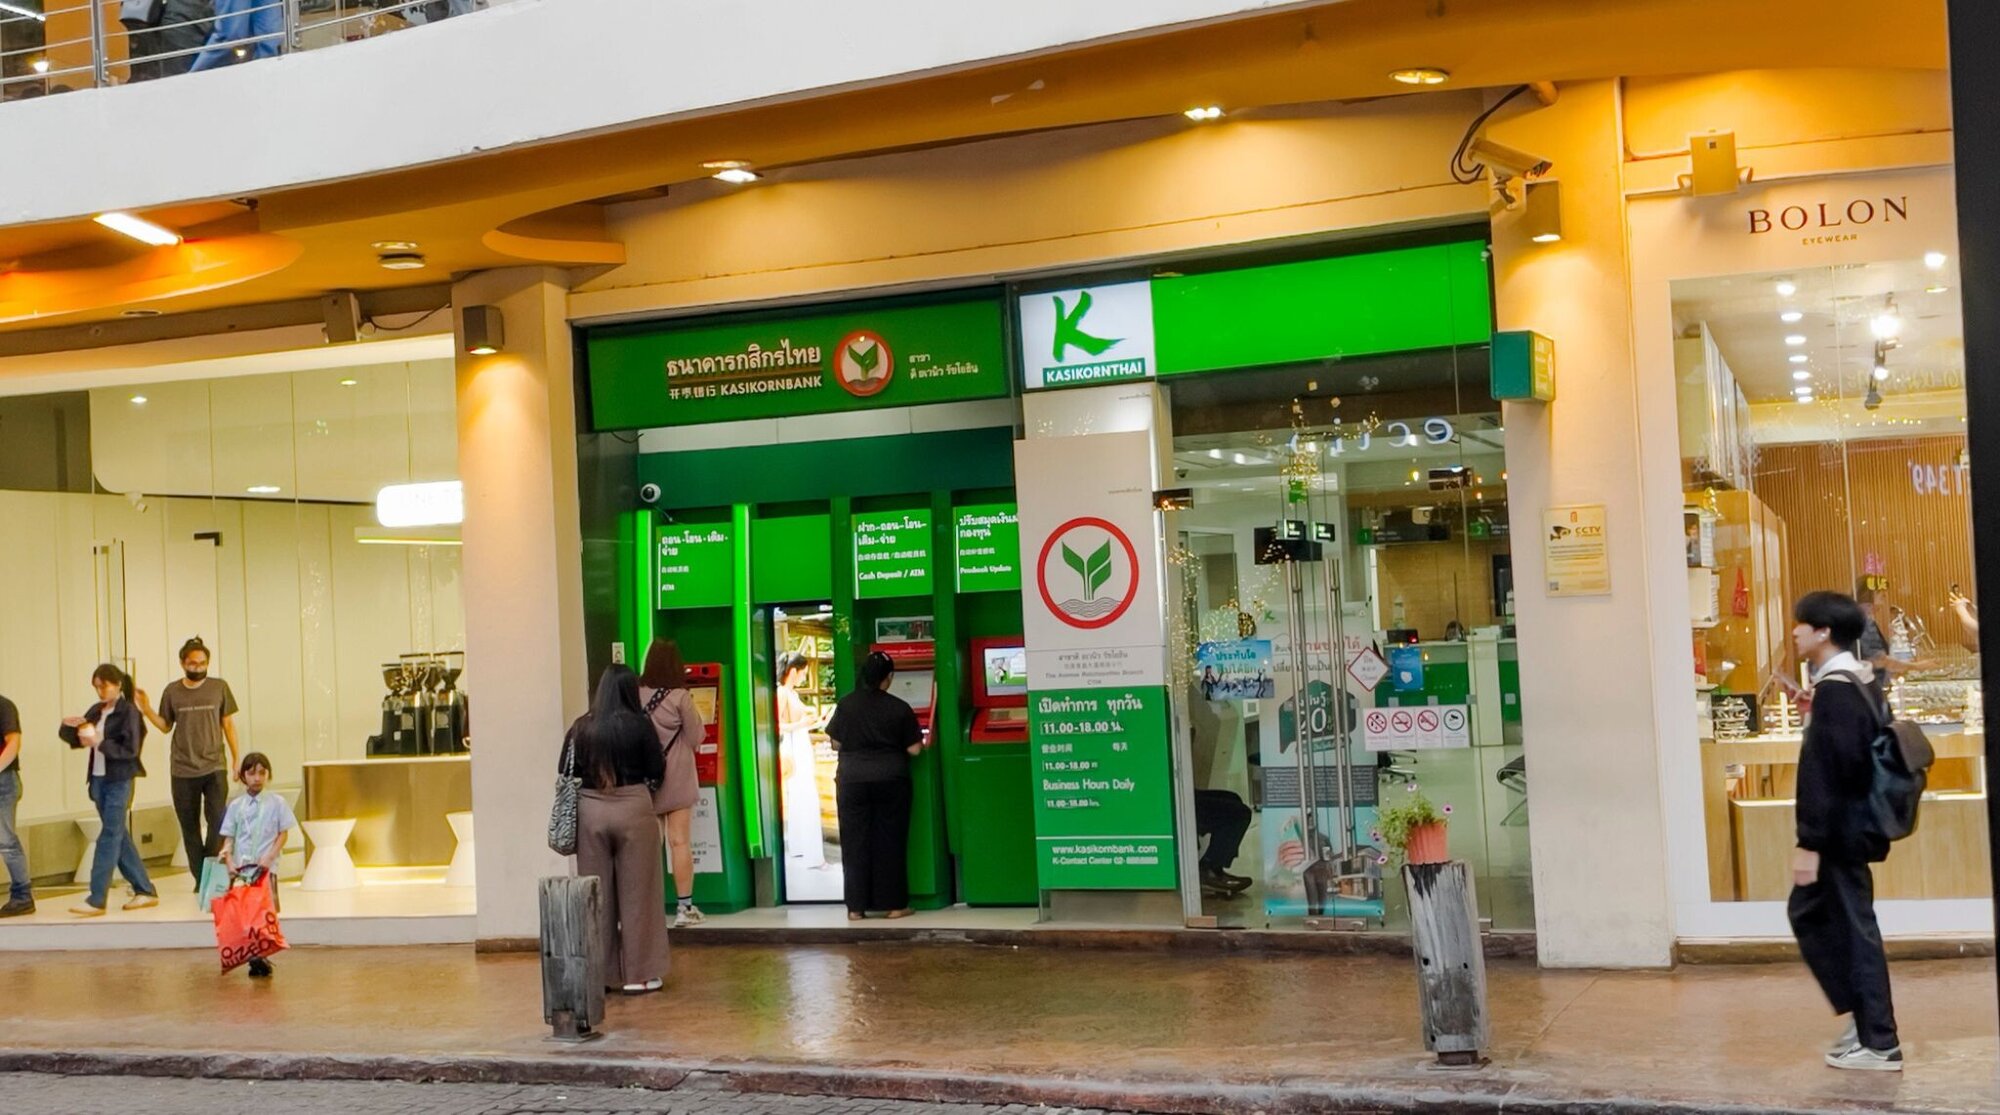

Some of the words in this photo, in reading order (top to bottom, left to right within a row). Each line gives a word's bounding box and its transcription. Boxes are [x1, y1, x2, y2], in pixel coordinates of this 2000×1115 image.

[1748, 196, 1907, 234] BOLON
[1802, 234, 1858, 245] EYEWEAR
[667, 338, 821, 377] ธนาคารกสิกรไทย
[1046, 361, 1141, 382] KASIKORNTHAI
[720, 376, 823, 396] KASIKORNBANK
[1575, 526, 1601, 535] CCTV
[1038, 696, 1098, 713] เปิดทำการ
[1106, 693, 1143, 716] ทุกวัน
[1043, 779, 1080, 790] Business
[1082, 778, 1109, 790] Hours
[1112, 777, 1135, 792] Daily
